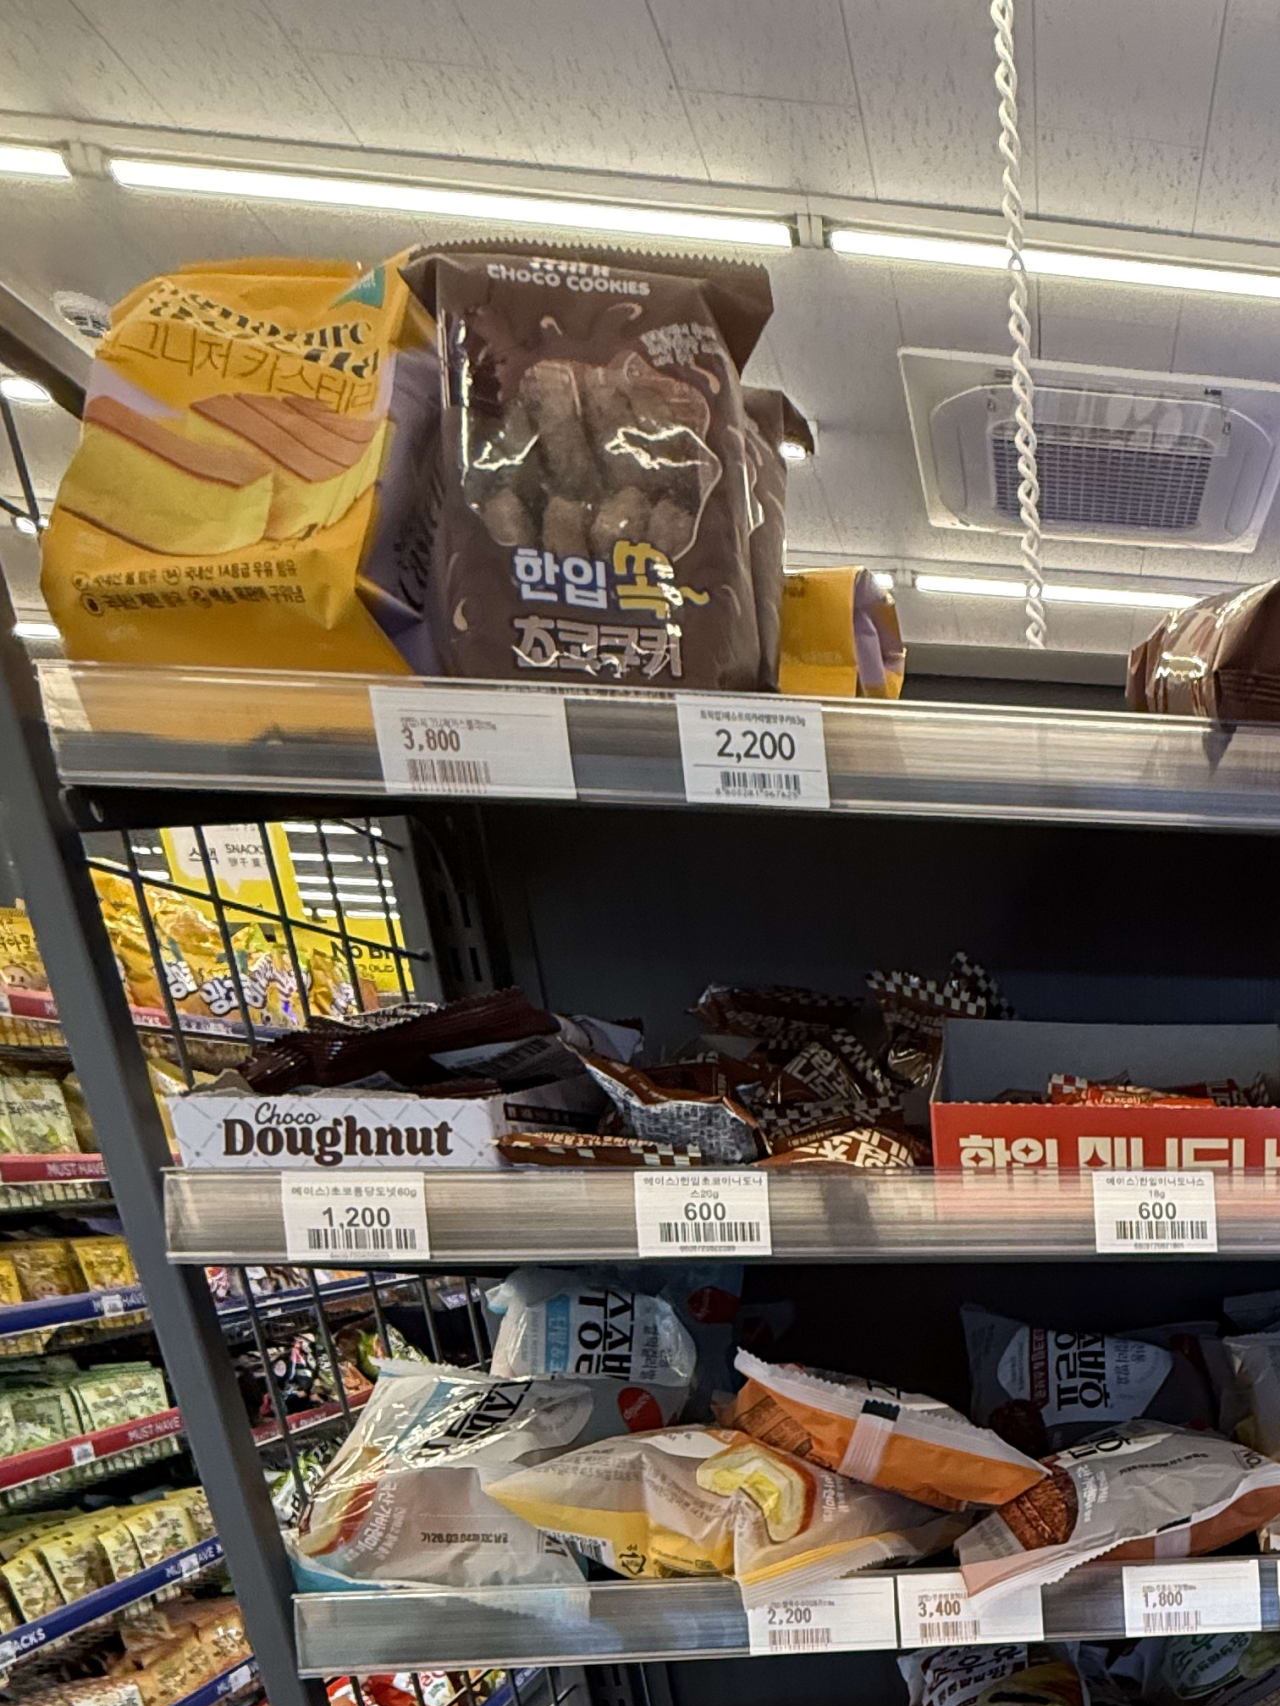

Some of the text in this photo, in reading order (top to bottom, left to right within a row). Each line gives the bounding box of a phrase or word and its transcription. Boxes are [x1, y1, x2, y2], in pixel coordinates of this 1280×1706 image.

[487, 264, 560, 288] CHOCO
[566, 273, 650, 297] COOKIES
[513, 548, 607, 610] 한입
[513, 615, 684, 678] 초코쿠키
[402, 728, 461, 753] 3,800
[716, 728, 796, 764] 2,200
[254, 1101, 321, 1126] Choco
[222, 1115, 454, 1167] Doughnut
[321, 1206, 392, 1230] 1,200
[683, 1202, 727, 1222] 600
[1138, 1201, 1177, 1221] 600
[918, 1598, 961, 1617] 3,400
[1143, 1591, 1183, 1608] 1,800
[767, 1606, 812, 1625] 2,200
